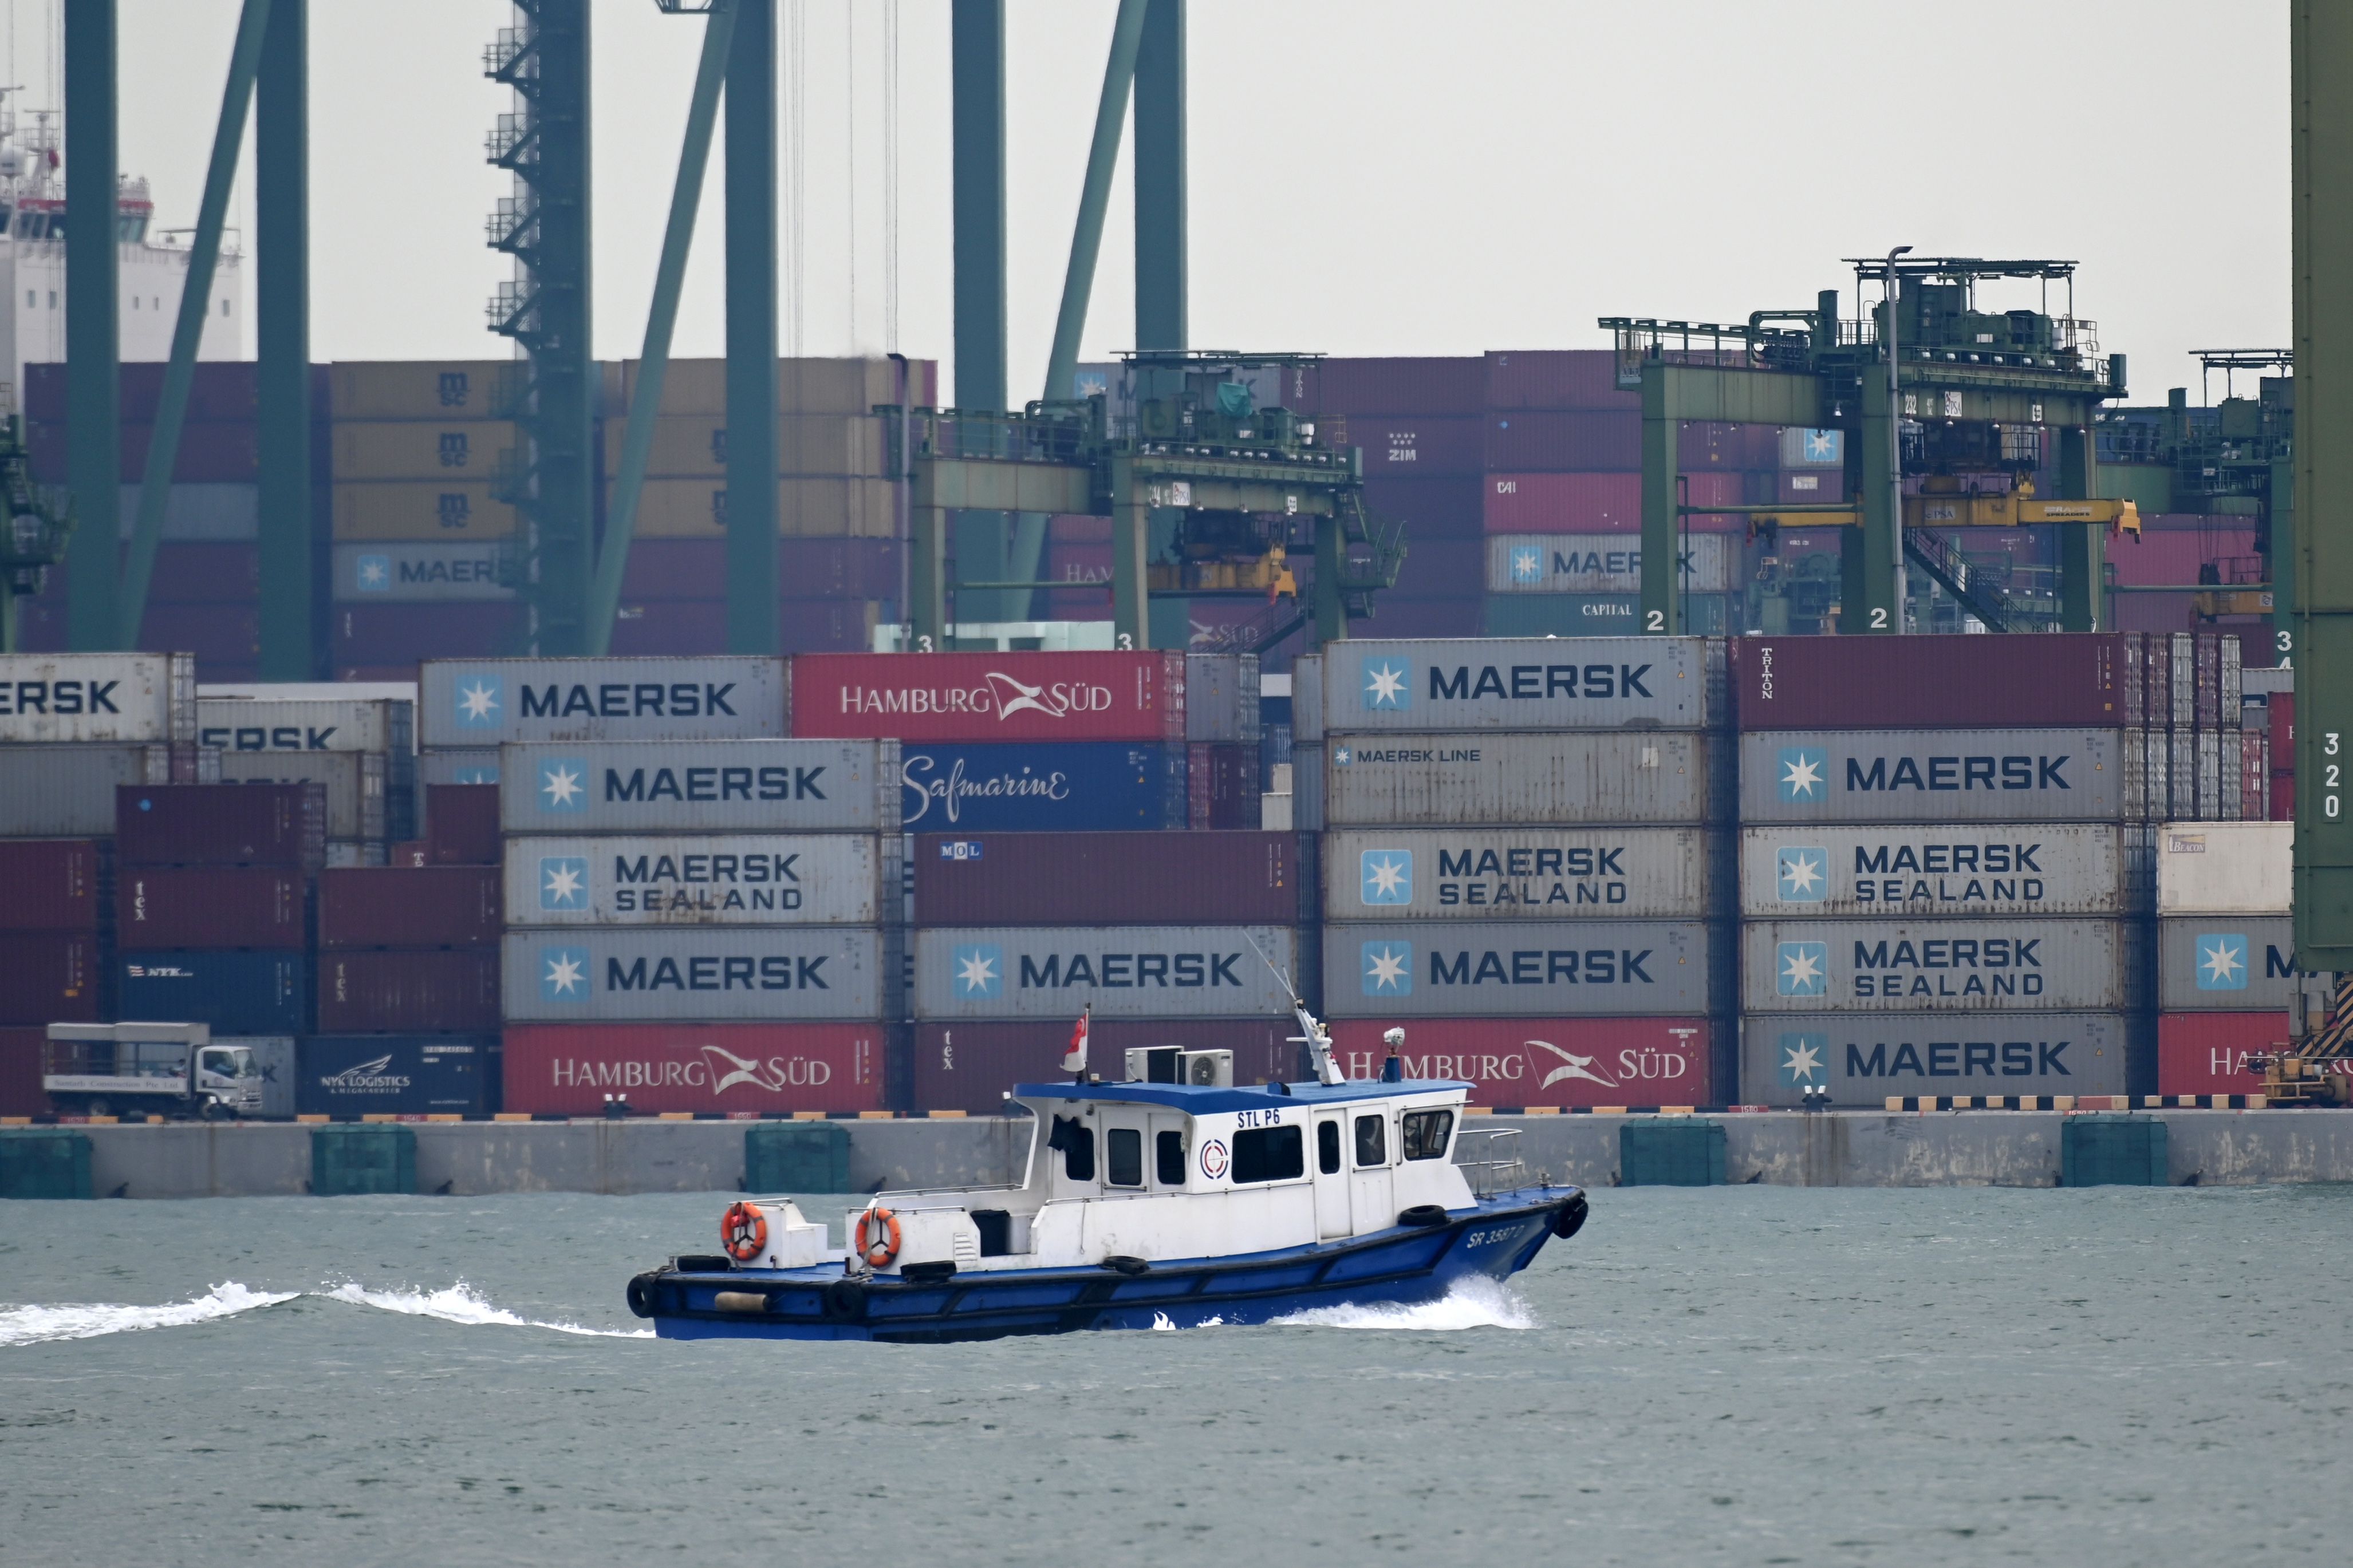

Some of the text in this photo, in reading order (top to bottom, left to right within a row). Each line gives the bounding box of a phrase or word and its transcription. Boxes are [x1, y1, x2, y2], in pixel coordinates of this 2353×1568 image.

[1906, 394, 1917, 414] 232
[1951, 401, 1962, 414] PSA
[1389, 449, 1416, 461] ZIM
[1934, 510, 1954, 519] PSA
[399, 560, 495, 583] MAER
[1554, 551, 1697, 573] MAERK
[1582, 605, 1632, 616] CAPITAL
[1647, 610, 1664, 631] 2
[1870, 608, 1887, 629] 2
[919, 635, 933, 653] 3
[1118, 633, 1132, 651] 3
[1430, 664, 1654, 700] MAERSK
[1761, 647, 1773, 699] TRITON
[521, 683, 738, 717] MAERSK
[842, 685, 990, 714] HAMBURG
[1051, 682, 1112, 712] SÜD
[1358, 749, 1481, 763] MAERSK LINE
[605, 766, 827, 801] MAERSK
[1847, 756, 2072, 791] MAERSK
[902, 756, 1069, 823] Safmarine
[941, 844, 980, 856] MOL
[1855, 844, 2042, 873] MAERSK
[2174, 842, 2205, 852] BEACON
[616, 854, 801, 883] MAERSK
[1439, 847, 1626, 876] MAERSK
[135, 880, 146, 921] tex
[616, 888, 802, 912] SEALAND
[1440, 882, 1627, 905] SEALAND
[1855, 879, 2044, 901] SEALAND
[1854, 939, 2041, 969] MAERSK
[148, 967, 182, 977] NYK
[608, 956, 830, 991] MAERSK
[1020, 953, 1243, 988] MAERSK
[1430, 949, 1654, 985] MAERSK
[1855, 974, 2043, 997] SEALAND
[943, 1030, 953, 1071] tex
[1847, 1041, 2072, 1077] MAERSK
[554, 1056, 831, 1087] HAMBURG SÜD
[1347, 1048, 1686, 1080] HMBURG SÜD
[90, 1080, 141, 1088] Construction
[145, 1081, 159, 1089] Pte
[321, 1076, 411, 1087] NYK LOGISTICS
[1237, 1109, 1280, 1128] STL P6
[1467, 1232, 1485, 1249] SR
